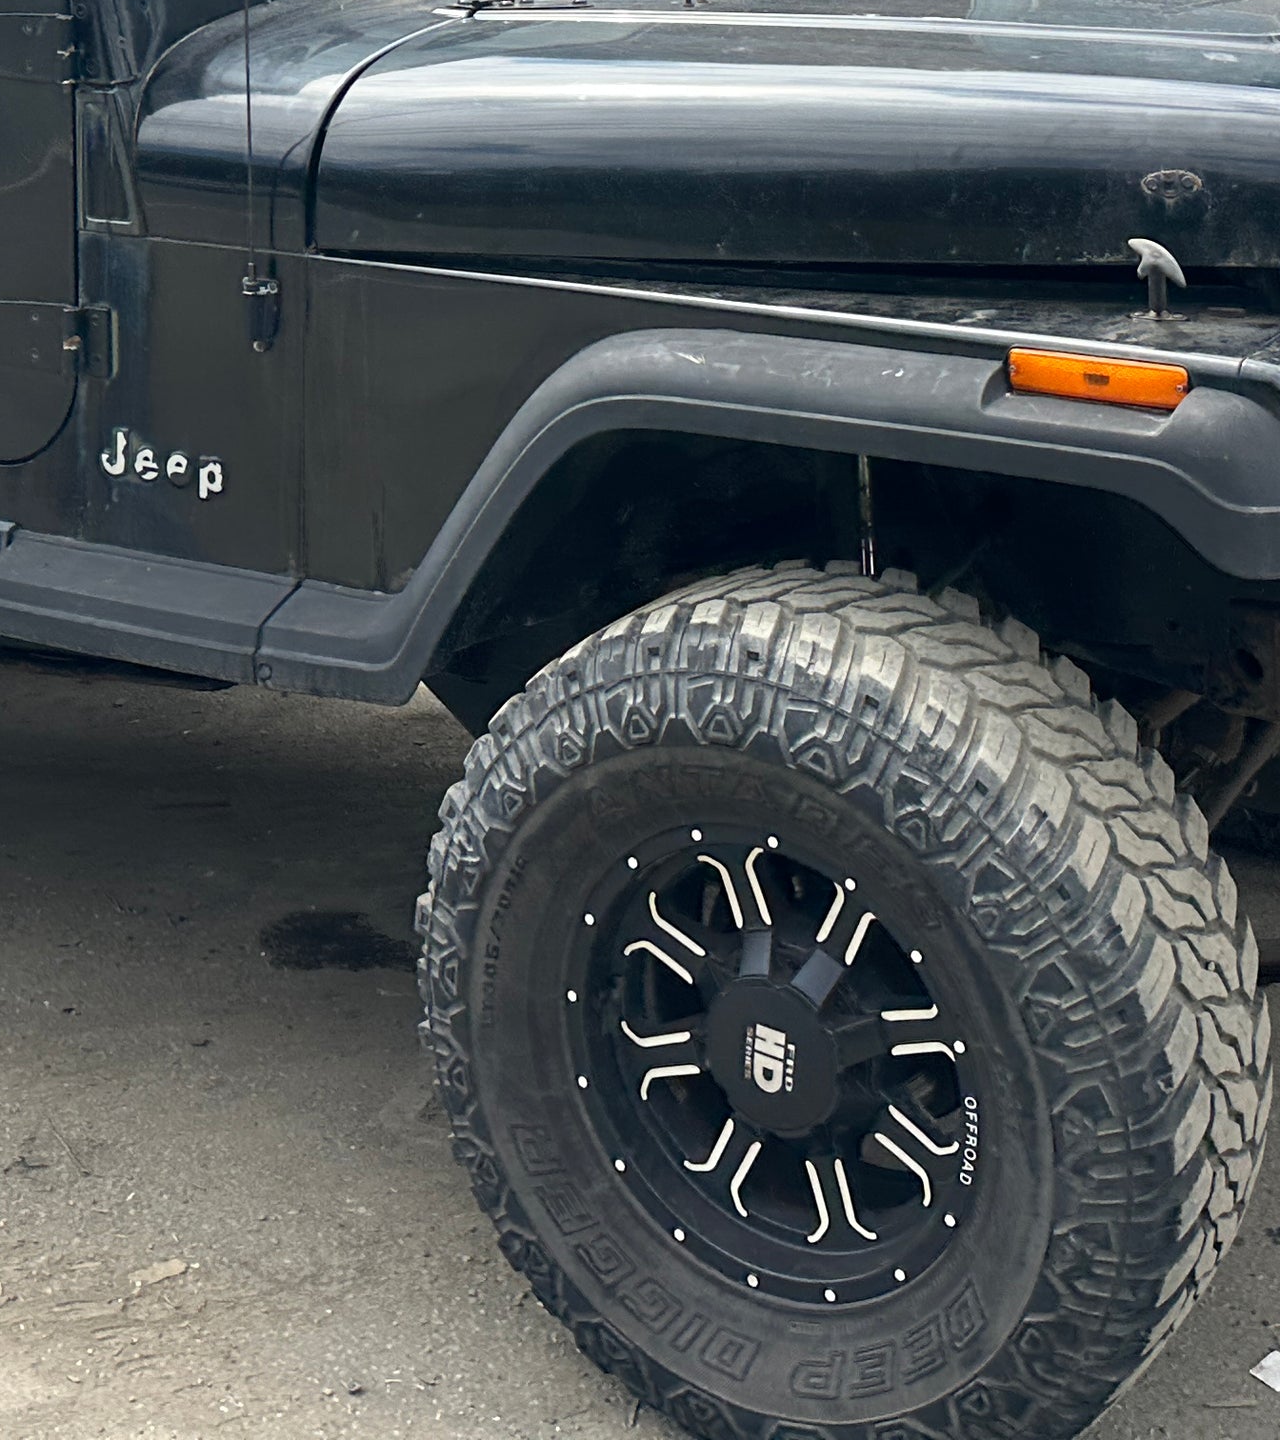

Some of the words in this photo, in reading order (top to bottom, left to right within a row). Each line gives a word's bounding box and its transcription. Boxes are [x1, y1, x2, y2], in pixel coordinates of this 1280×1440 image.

[100, 430, 224, 500] Jeep
[753, 1023, 787, 1094] HD
[960, 1096, 979, 1187] OFFROAD
[506, 1122, 764, 1382] DIGGER
[788, 1277, 990, 1402] DEEP
